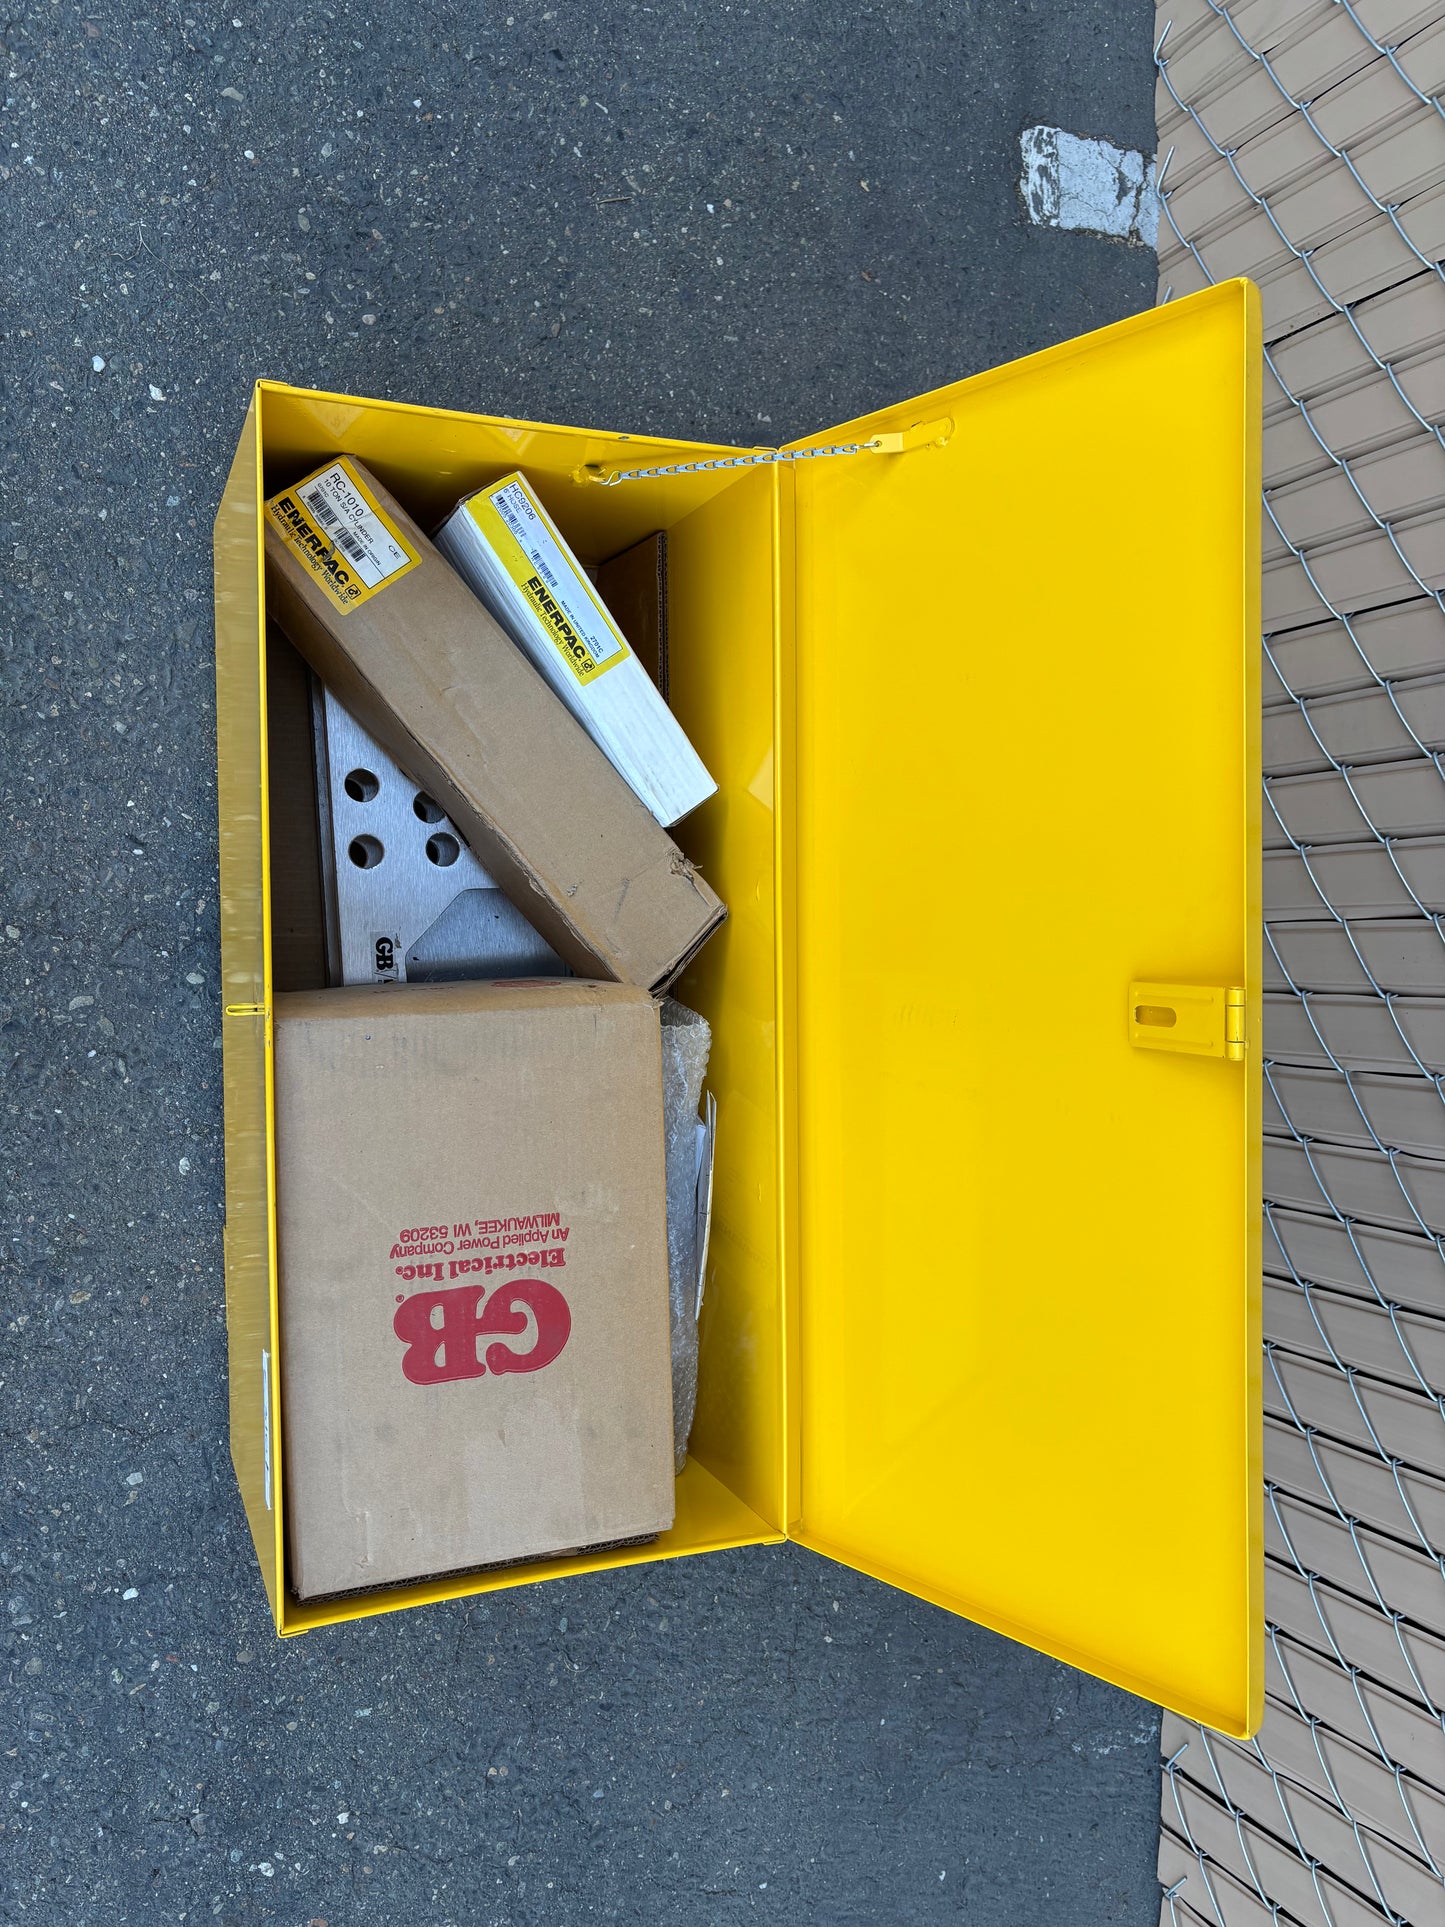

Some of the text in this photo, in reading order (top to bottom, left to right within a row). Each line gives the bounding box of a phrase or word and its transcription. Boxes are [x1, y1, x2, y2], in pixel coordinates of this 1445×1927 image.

[323, 478, 374, 544] 10 TON S/A CYLINDER
[329, 472, 365, 517] RC-1010
[506, 493, 521, 513] HOSE
[508, 483, 536, 521] HC9206
[268, 504, 298, 538] Hydraulic
[293, 535, 322, 572] Technology
[320, 570, 349, 604] Worldwide
[276, 496, 350, 586] ENERPAC
[352, 530, 364, 545] MADE
[387, 543, 401, 560] CE
[520, 582, 543, 613] Hydraulic
[538, 610, 564, 646] Technology
[560, 644, 585, 677] Worldwide
[527, 576, 586, 660] ENERPAC
[560, 600, 571, 614] MADE
[572, 619, 586, 637] UNITED
[583, 635, 600, 658] KINGDOM
[376, 937, 393, 970] GB
[390, 1227, 570, 1259] An Applied Power Company
[400, 1212, 560, 1243] MILWAUKEE, WI 53209
[395, 1248, 566, 1281] Electrical Inc.
[393, 1279, 571, 1385] GB
